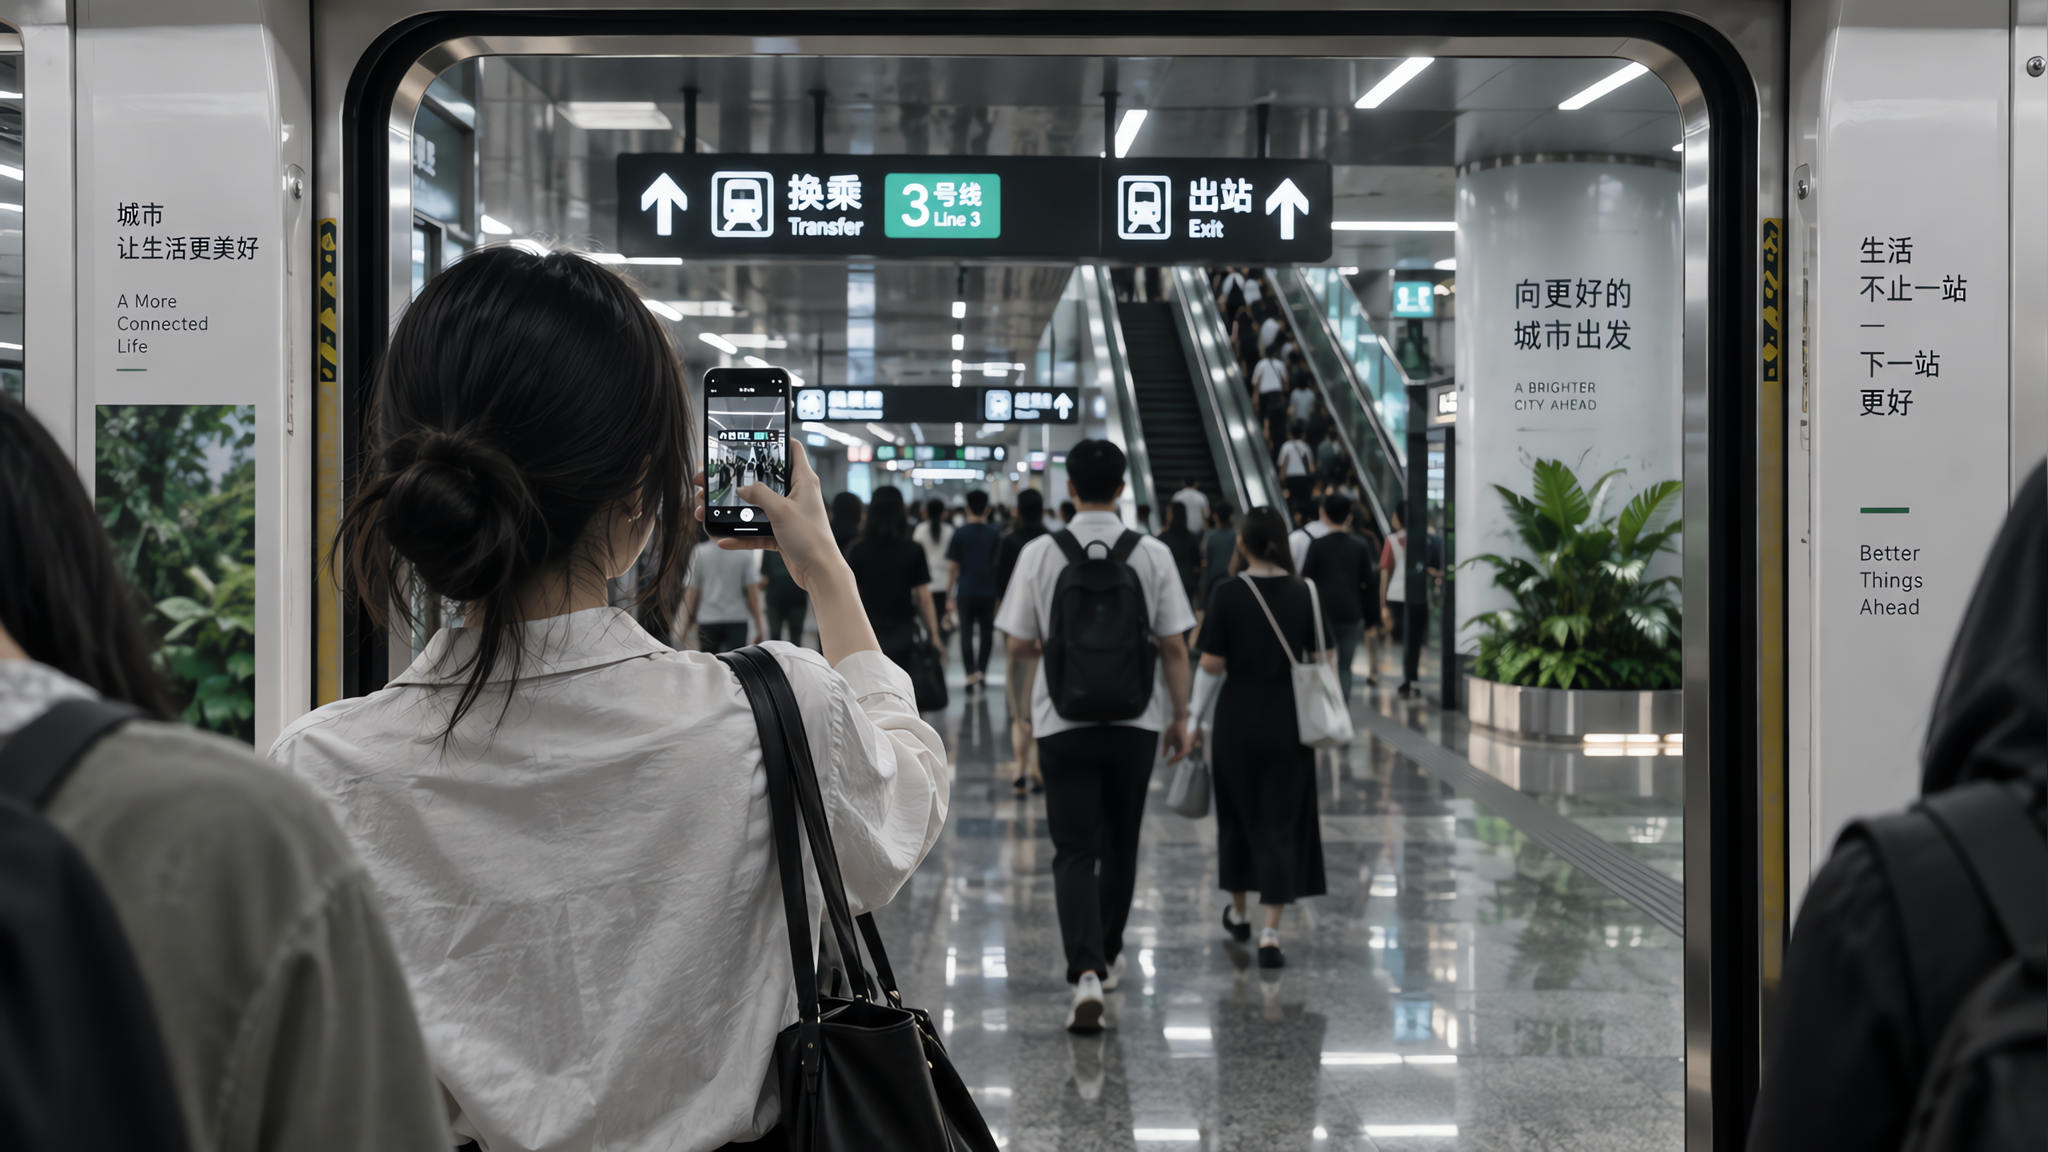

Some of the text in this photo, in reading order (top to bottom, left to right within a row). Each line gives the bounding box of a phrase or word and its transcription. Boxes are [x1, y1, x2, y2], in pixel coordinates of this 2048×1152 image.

[788, 173, 863, 212] 换乘
[901, 181, 983, 228] 3 号线
[1188, 176, 1254, 214] 出站
[117, 202, 164, 228] 城市
[788, 216, 865, 237] Transfer
[933, 210, 982, 228] Line 3
[1188, 218, 1226, 239] Exit
[117, 235, 259, 261] 让生活更美好
[1860, 235, 1914, 265] 生活
[1515, 277, 1631, 310] 向更好的
[1859, 274, 1968, 303] 不止一站
[117, 293, 177, 309] A More
[117, 315, 208, 331] Connected
[1514, 318, 1632, 351] 城市出发
[117, 338, 149, 354] Life
[1860, 349, 1941, 378] 下一站
[1514, 381, 1597, 394] A BRIGHTER
[1514, 399, 1597, 411] CITY AHEAD
[1859, 387, 1914, 417] 更好
[1860, 544, 1921, 562] Better
[1859, 571, 1923, 593] Things
[1859, 598, 1920, 616] Ahead
